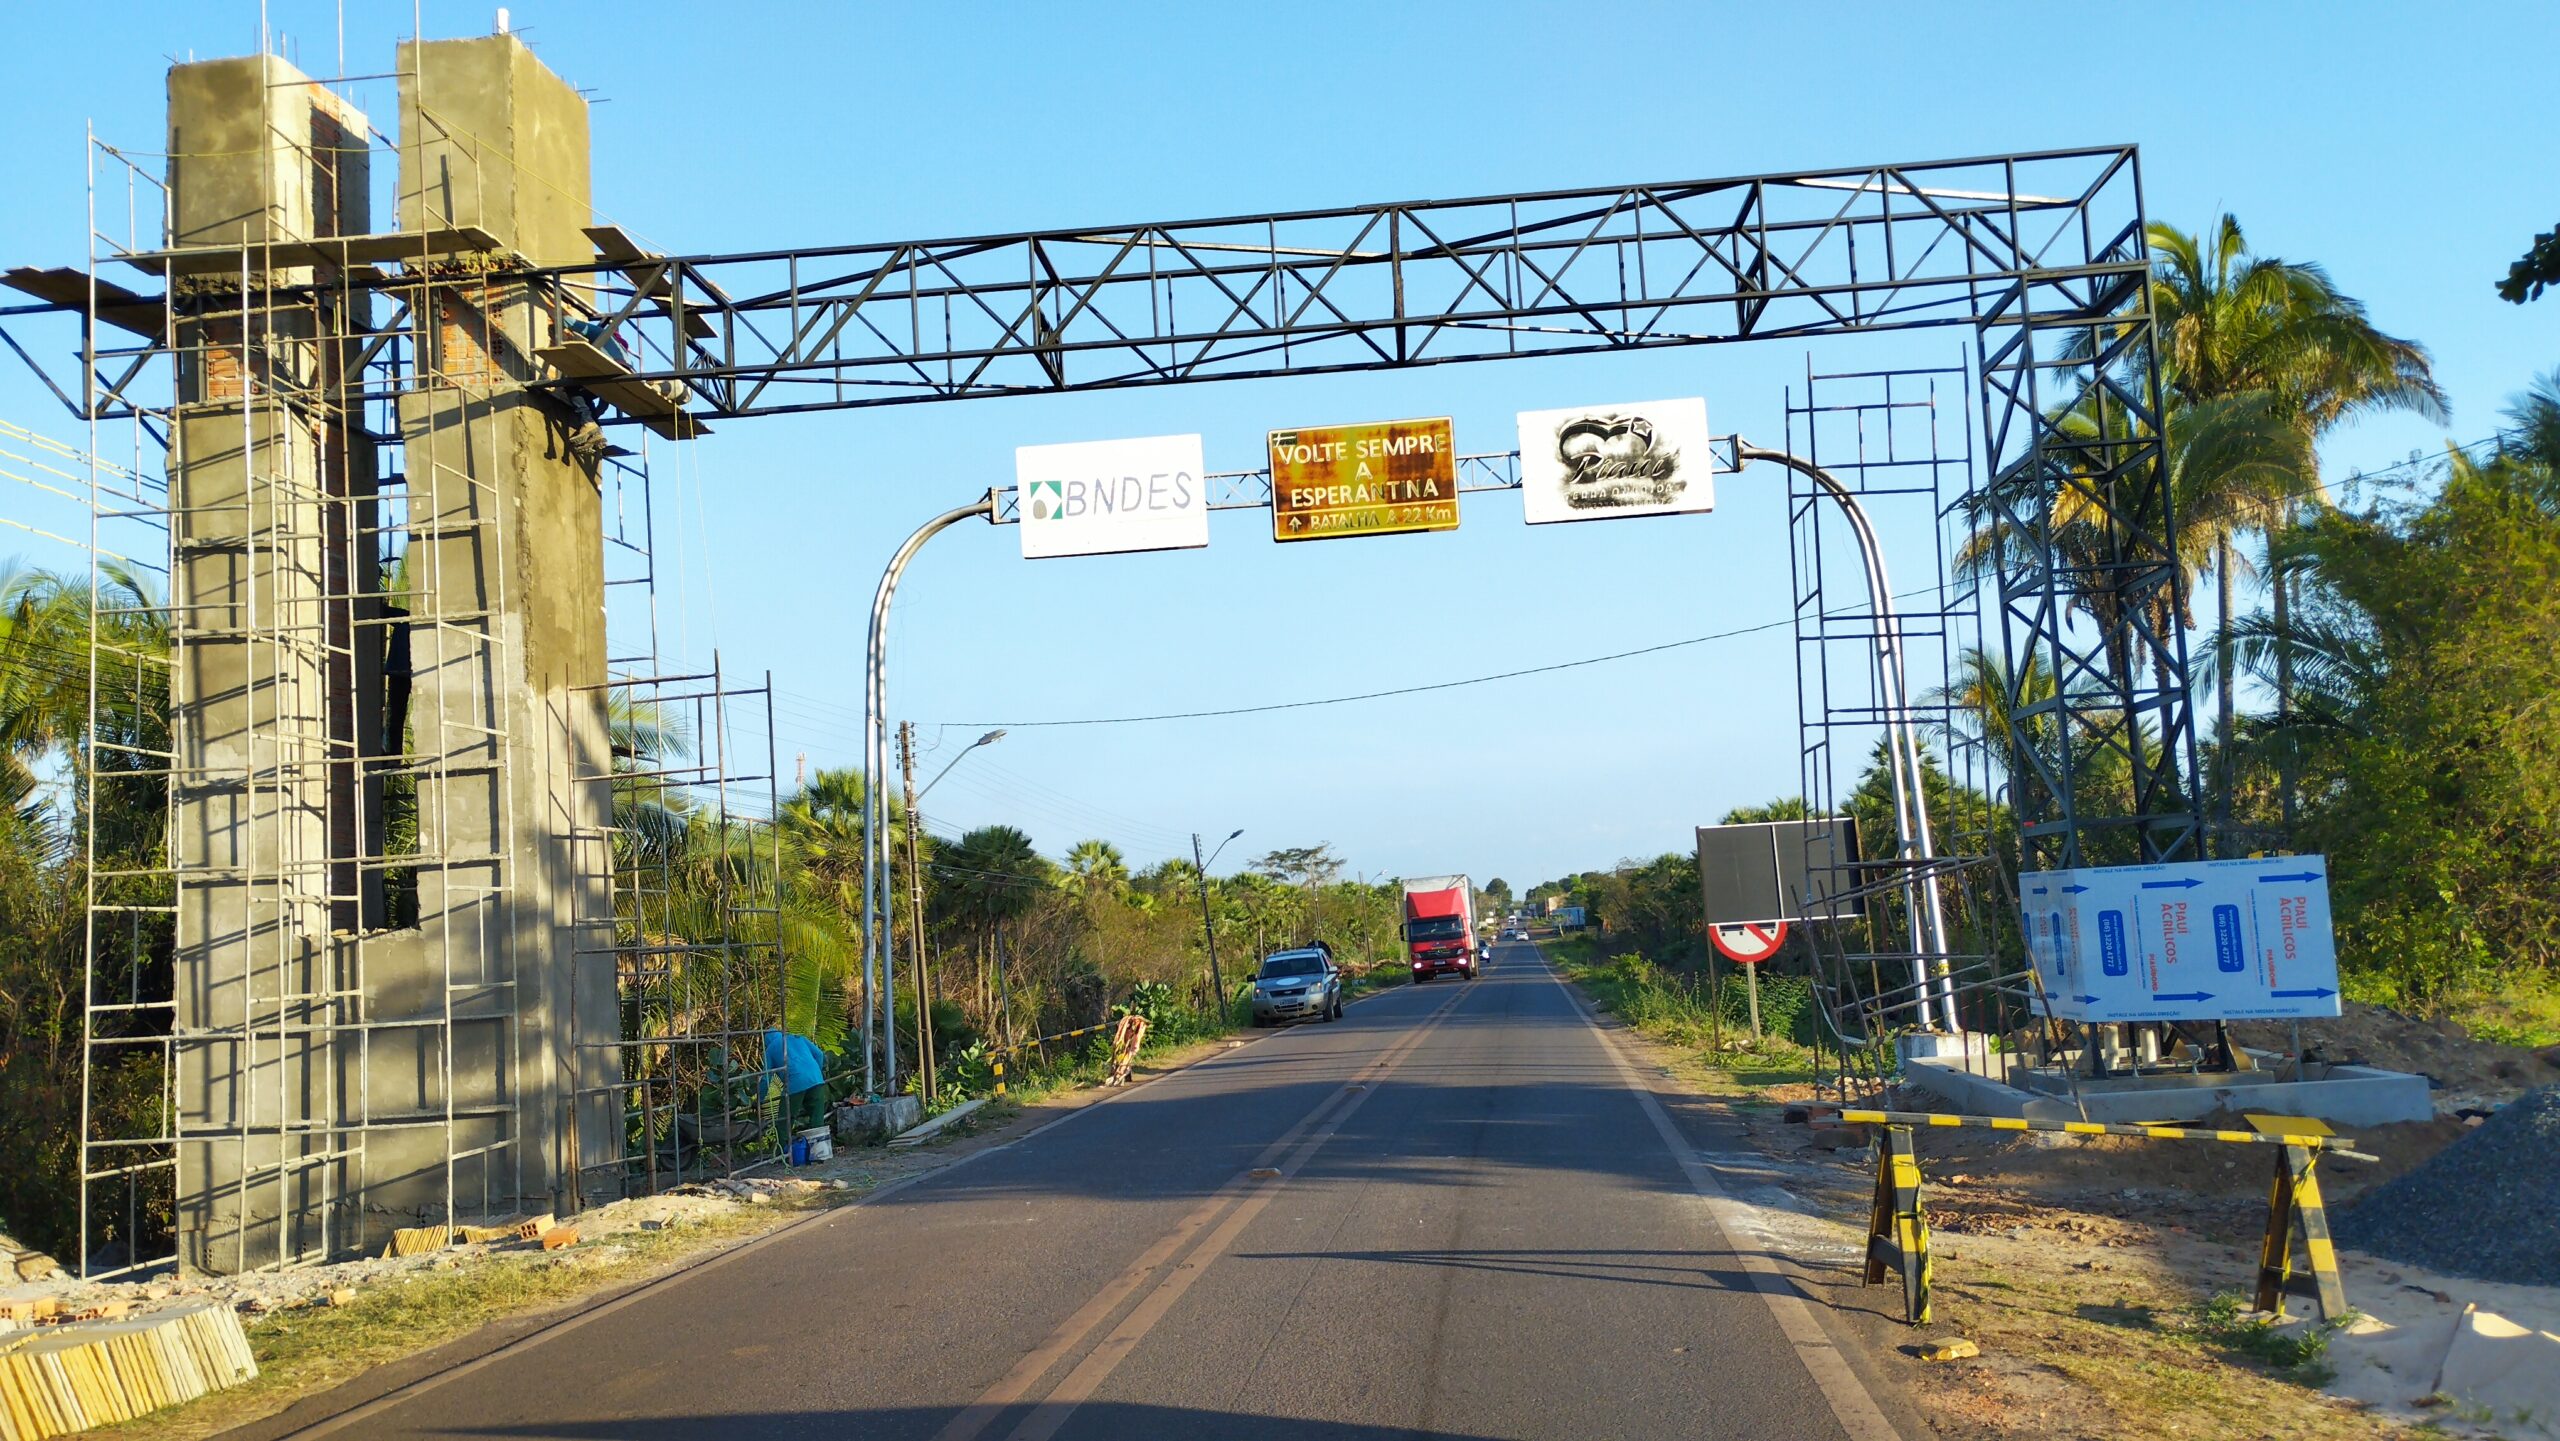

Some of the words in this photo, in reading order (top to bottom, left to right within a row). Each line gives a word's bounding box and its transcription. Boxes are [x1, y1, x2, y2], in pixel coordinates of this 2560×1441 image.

[1277, 442, 1348, 465] VOLTE
[1356, 433, 1448, 459] SEMPRE
[1355, 462, 1373, 481] A
[1569, 451, 1671, 484] Piauí
[1066, 471, 1193, 516] BNDES
[1291, 478, 1439, 508] ESPERANTINA
[1310, 510, 1380, 531] BATALHA
[1386, 509, 1399, 525] A
[1402, 507, 1423, 524] 22
[1426, 505, 1451, 522] Km
[2295, 896, 2310, 929] PIAUÍ
[2104, 933, 2113, 950] 3220
[2222, 947, 2231, 964] 4777
[2106, 951, 2114, 968] 4777
